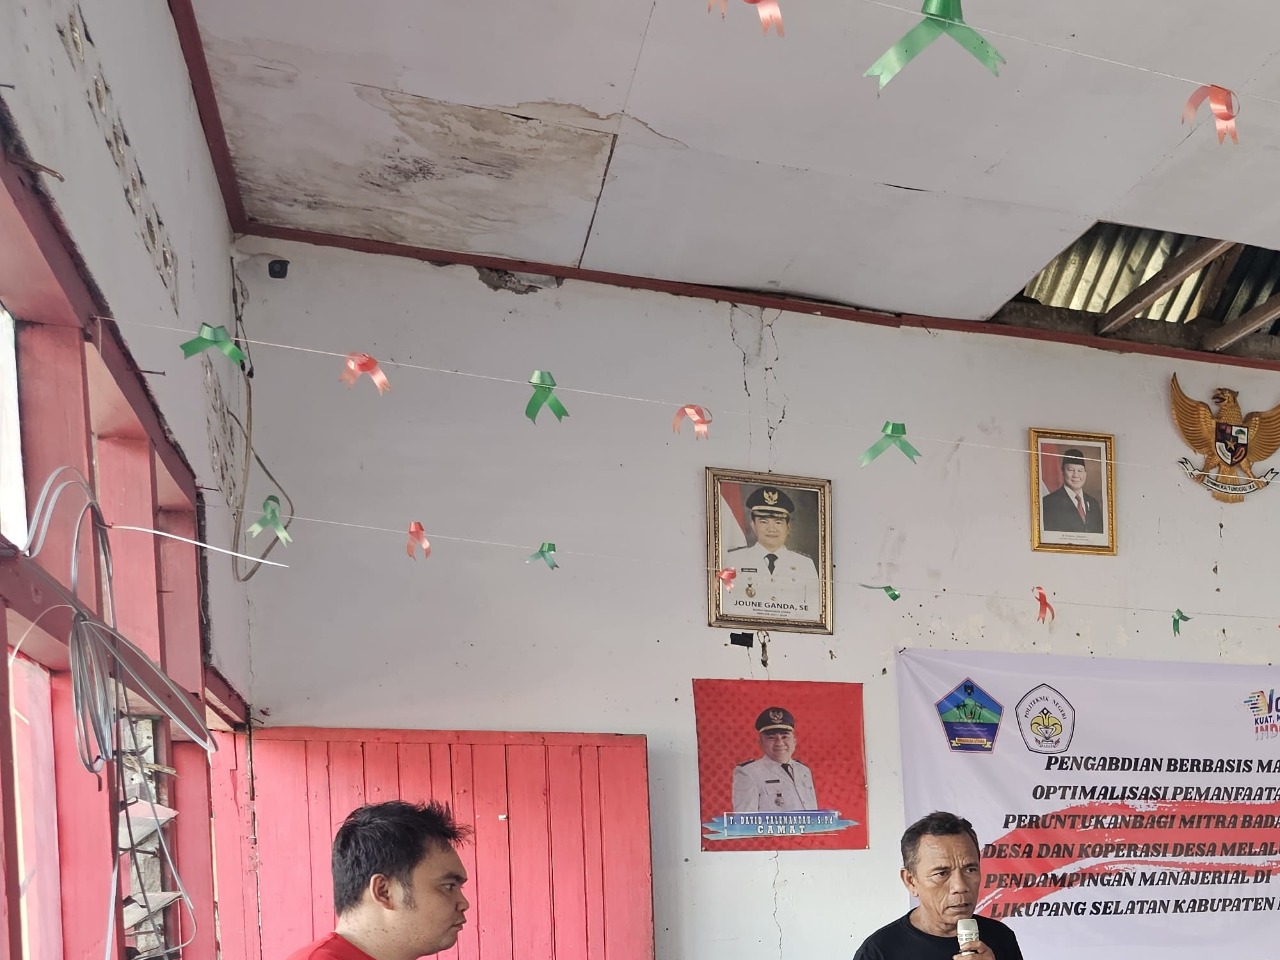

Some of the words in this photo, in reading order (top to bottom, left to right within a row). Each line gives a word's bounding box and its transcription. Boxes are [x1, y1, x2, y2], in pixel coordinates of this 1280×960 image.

[734, 600, 762, 608] JOUNE
[764, 602, 797, 611] GANDA,
[1024, 695, 1050, 719] POLITEKNIK
[1052, 699, 1067, 720] NEGERI
[1254, 716, 1275, 726] KUAT,
[1045, 755, 1164, 772] PENGABDIAN
[1166, 758, 1253, 773] BERBASIS
[1032, 785, 1170, 801] OPTIMALISASI
[757, 825, 806, 834] CAMAT
[1178, 814, 1238, 829] MITRA
[981, 843, 1035, 859] DESA
[1036, 843, 1075, 858] DAN
[1076, 843, 1170, 858] KOPERASI
[1171, 842, 1217, 857] DESA
[984, 871, 1136, 889] PENDAMPINGAN
[1138, 869, 1250, 887] MANAJERIAL
[1252, 869, 1272, 884] DI
[990, 901, 1086, 918] LIKUPANG
[1088, 899, 1170, 916] SELATAN
[1172, 896, 1276, 914] KABUPATEN
